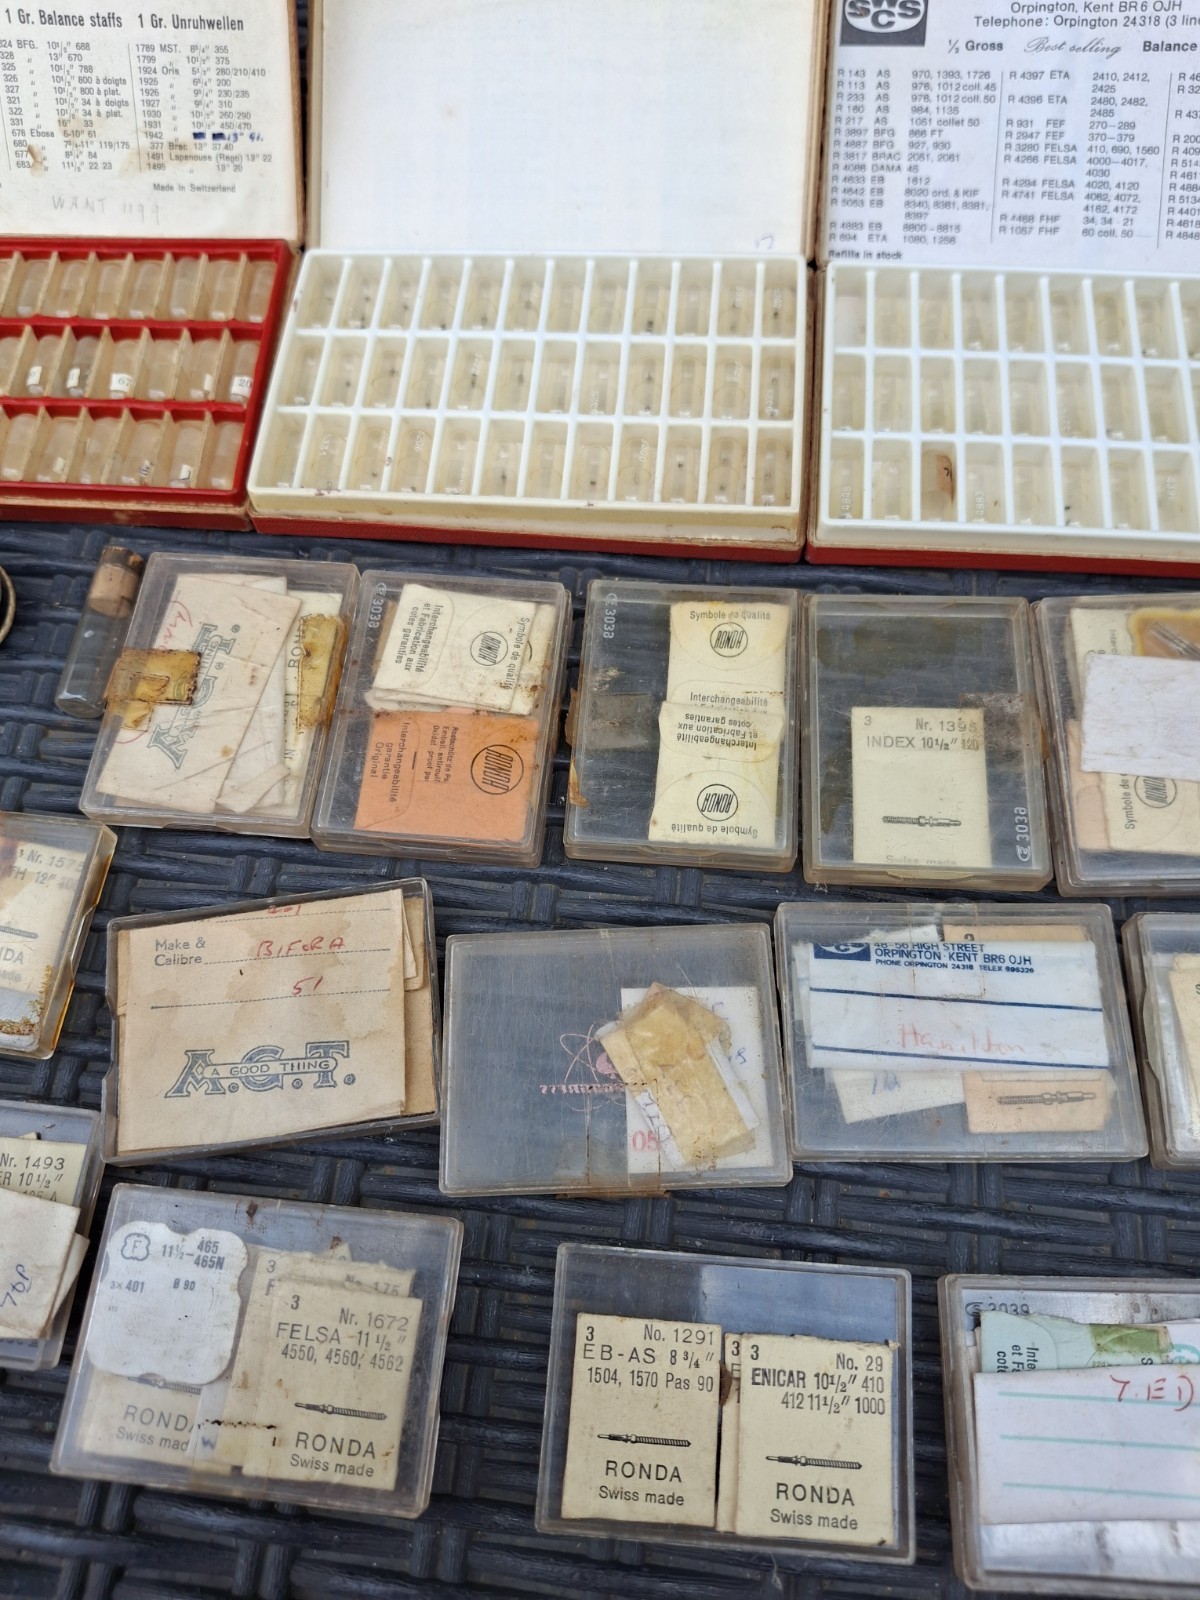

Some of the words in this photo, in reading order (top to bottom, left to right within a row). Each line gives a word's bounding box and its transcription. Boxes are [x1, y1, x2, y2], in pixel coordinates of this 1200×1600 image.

[1010, 1, 1078, 14] Orpington,
[1084, 1, 1116, 13] Kent
[5, 8, 12, 24] 1
[18, 8, 34, 24] Gr.
[38, 10, 85, 26] Balance
[90, 12, 122, 28] staffs
[138, 13, 144, 28] 1
[150, 14, 167, 29] Gr.
[172, 14, 244, 31] Unruhwellen
[974, 16, 1049, 28] Telephone:
[1054, 16, 1118, 29] Orpington
[1122, 16, 1161, 28] 24318
[965, 40, 1004, 52] Gross
[1024, 37, 1066, 54] Best
[1069, 38, 1122, 60] selling
[1143, 40, 1198, 53] Balance
[407, 606, 418, 626] cotes
[690, 610, 727, 620] Symbole
[409, 612, 429, 655] Fabrication
[414, 604, 444, 673] Interchangeabilité
[514, 617, 530, 648] Symbole
[394, 628, 412, 664] garanties
[404, 658, 414, 672] aux
[511, 651, 520, 661] de
[690, 692, 768, 707] Interchangeabilité
[677, 722, 694, 730] aux
[685, 714, 726, 725] garanties
[864, 716, 872, 726] 3
[915, 718, 932, 731] Nr.
[676, 732, 757, 751] Interchangeabilité
[696, 725, 746, 740] Fabrication
[866, 736, 916, 749] INDEX
[370, 742, 384, 778] Original
[382, 742, 394, 780] garantie
[389, 722, 410, 804] Interchangeabilité
[671, 823, 704, 834] qualité
[706, 826, 718, 834] de
[720, 826, 758, 839] Symbole
[154, 938, 191, 952] Make
[196, 936, 206, 949] &
[942, 942, 985, 953] STREET
[154, 954, 203, 967] Calibre
[875, 949, 942, 960] ORPINGTON
[950, 952, 978, 963] KENT
[984, 954, 1005, 964] BR6
[876, 959, 901, 967] PHONE
[904, 960, 948, 970] ORPINGTON
[211, 1065, 220, 1077] A
[230, 1063, 270, 1076] GOOD
[280, 1060, 330, 1072] THING
[26, 1155, 65, 1170] 1493
[197, 1240, 220, 1254] 465
[194, 1254, 226, 1270] 465N
[266, 1260, 276, 1273] 3
[125, 1280, 145, 1294] 401
[183, 1280, 196, 1291] 90
[290, 1294, 300, 1310] 3
[339, 1308, 358, 1326] Nr.
[367, 1312, 409, 1332] 1672
[276, 1322, 341, 1344] FELSA
[584, 1326, 595, 1342] 3
[643, 1324, 666, 1342] No.
[672, 1328, 714, 1346] 1291
[731, 1340, 740, 1356] 3
[281, 1343, 317, 1365] 4550,
[370, 1353, 404, 1372] 4562
[750, 1344, 760, 1361] 3
[836, 1352, 858, 1371] No.
[865, 1355, 884, 1372] 29
[587, 1366, 622, 1387] 1504,
[630, 1370, 658, 1388] 1570
[665, 1373, 691, 1392] Pas
[697, 1375, 714, 1392] 90
[751, 1366, 806, 1389] ENICAR
[861, 1375, 885, 1394] 410
[781, 1391, 804, 1410] 412
[854, 1397, 886, 1415] 1000
[116, 1426, 154, 1446] Swiss
[158, 1432, 190, 1451] mad
[295, 1432, 376, 1460] RONDA
[290, 1453, 329, 1472] Swiss
[334, 1461, 374, 1478] made
[605, 1460, 682, 1484] RONDA
[598, 1486, 640, 1502] Swiss
[645, 1490, 684, 1506] made
[776, 1482, 854, 1506] RONDA
[770, 1508, 813, 1526] Swiss
[817, 1514, 858, 1530] made
